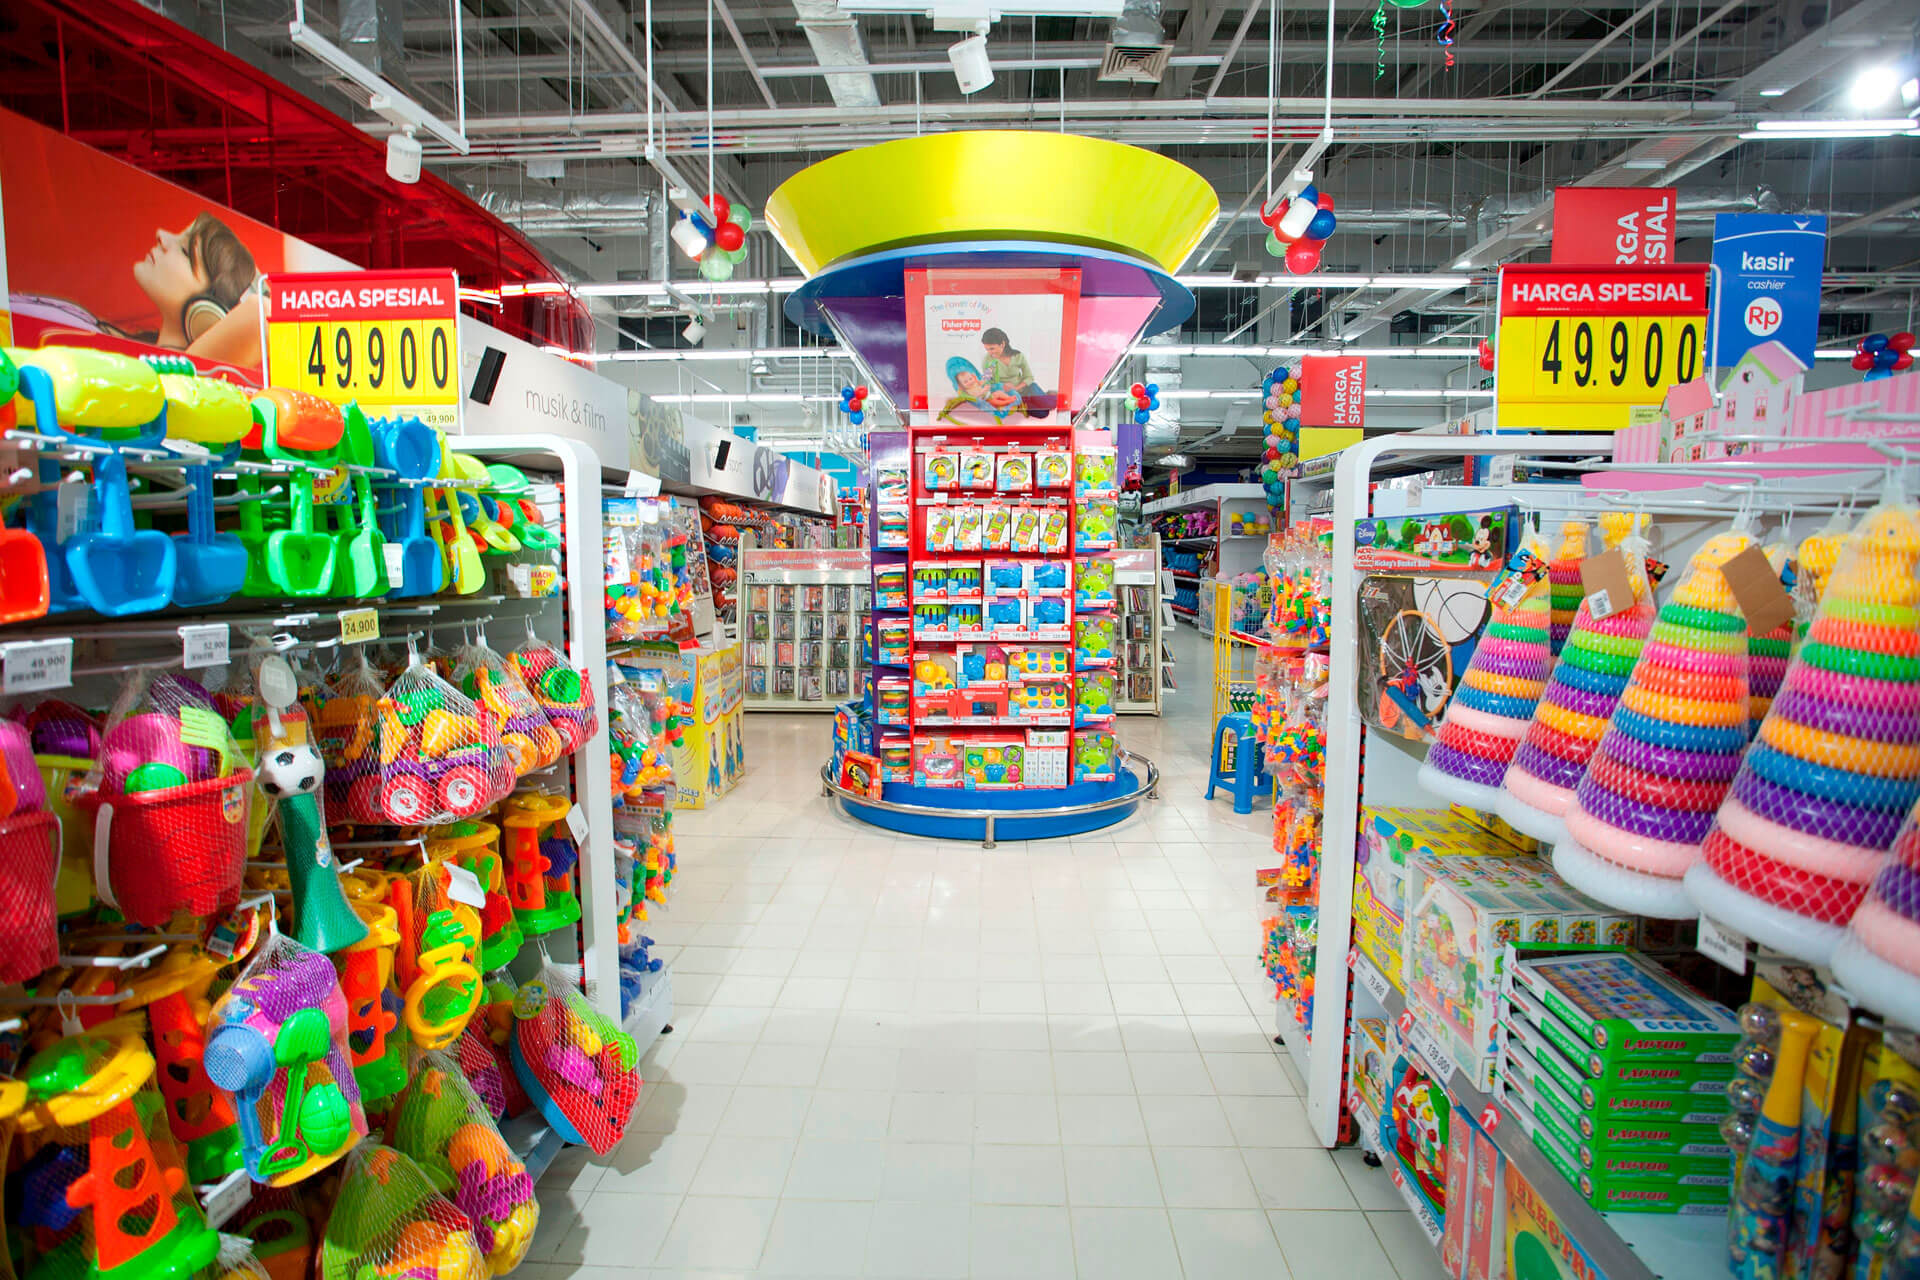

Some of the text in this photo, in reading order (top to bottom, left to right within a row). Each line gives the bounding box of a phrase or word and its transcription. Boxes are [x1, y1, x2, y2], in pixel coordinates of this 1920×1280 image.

[1615, 211, 1640, 265] RGA
[1643, 196, 1669, 265] SIAL
[1742, 251, 1795, 271] kasir
[1512, 283, 1693, 302] HARGA SPESIAL
[1747, 279, 1786, 290] cashier
[281, 287, 445, 309] HARGA SPESIAL
[1748, 306, 1779, 330] Rp
[308, 326, 448, 389] 49.900
[1542, 320, 1697, 387] 49.900
[1333, 368, 1348, 424] HARGA
[1348, 360, 1363, 425] SPESIAL
[525, 389, 606, 432] musik & film
[344, 619, 376, 636] 24,900
[1623, 1039, 1686, 1050] LAPTOP
[1618, 1068, 1680, 1080] LAPTOP
[1608, 1097, 1672, 1110] LAPTOP
[1607, 1128, 1670, 1141] LAPTOP
[1606, 1159, 1669, 1172] LAPTOP
[1607, 1189, 1669, 1202] LAPTOP
